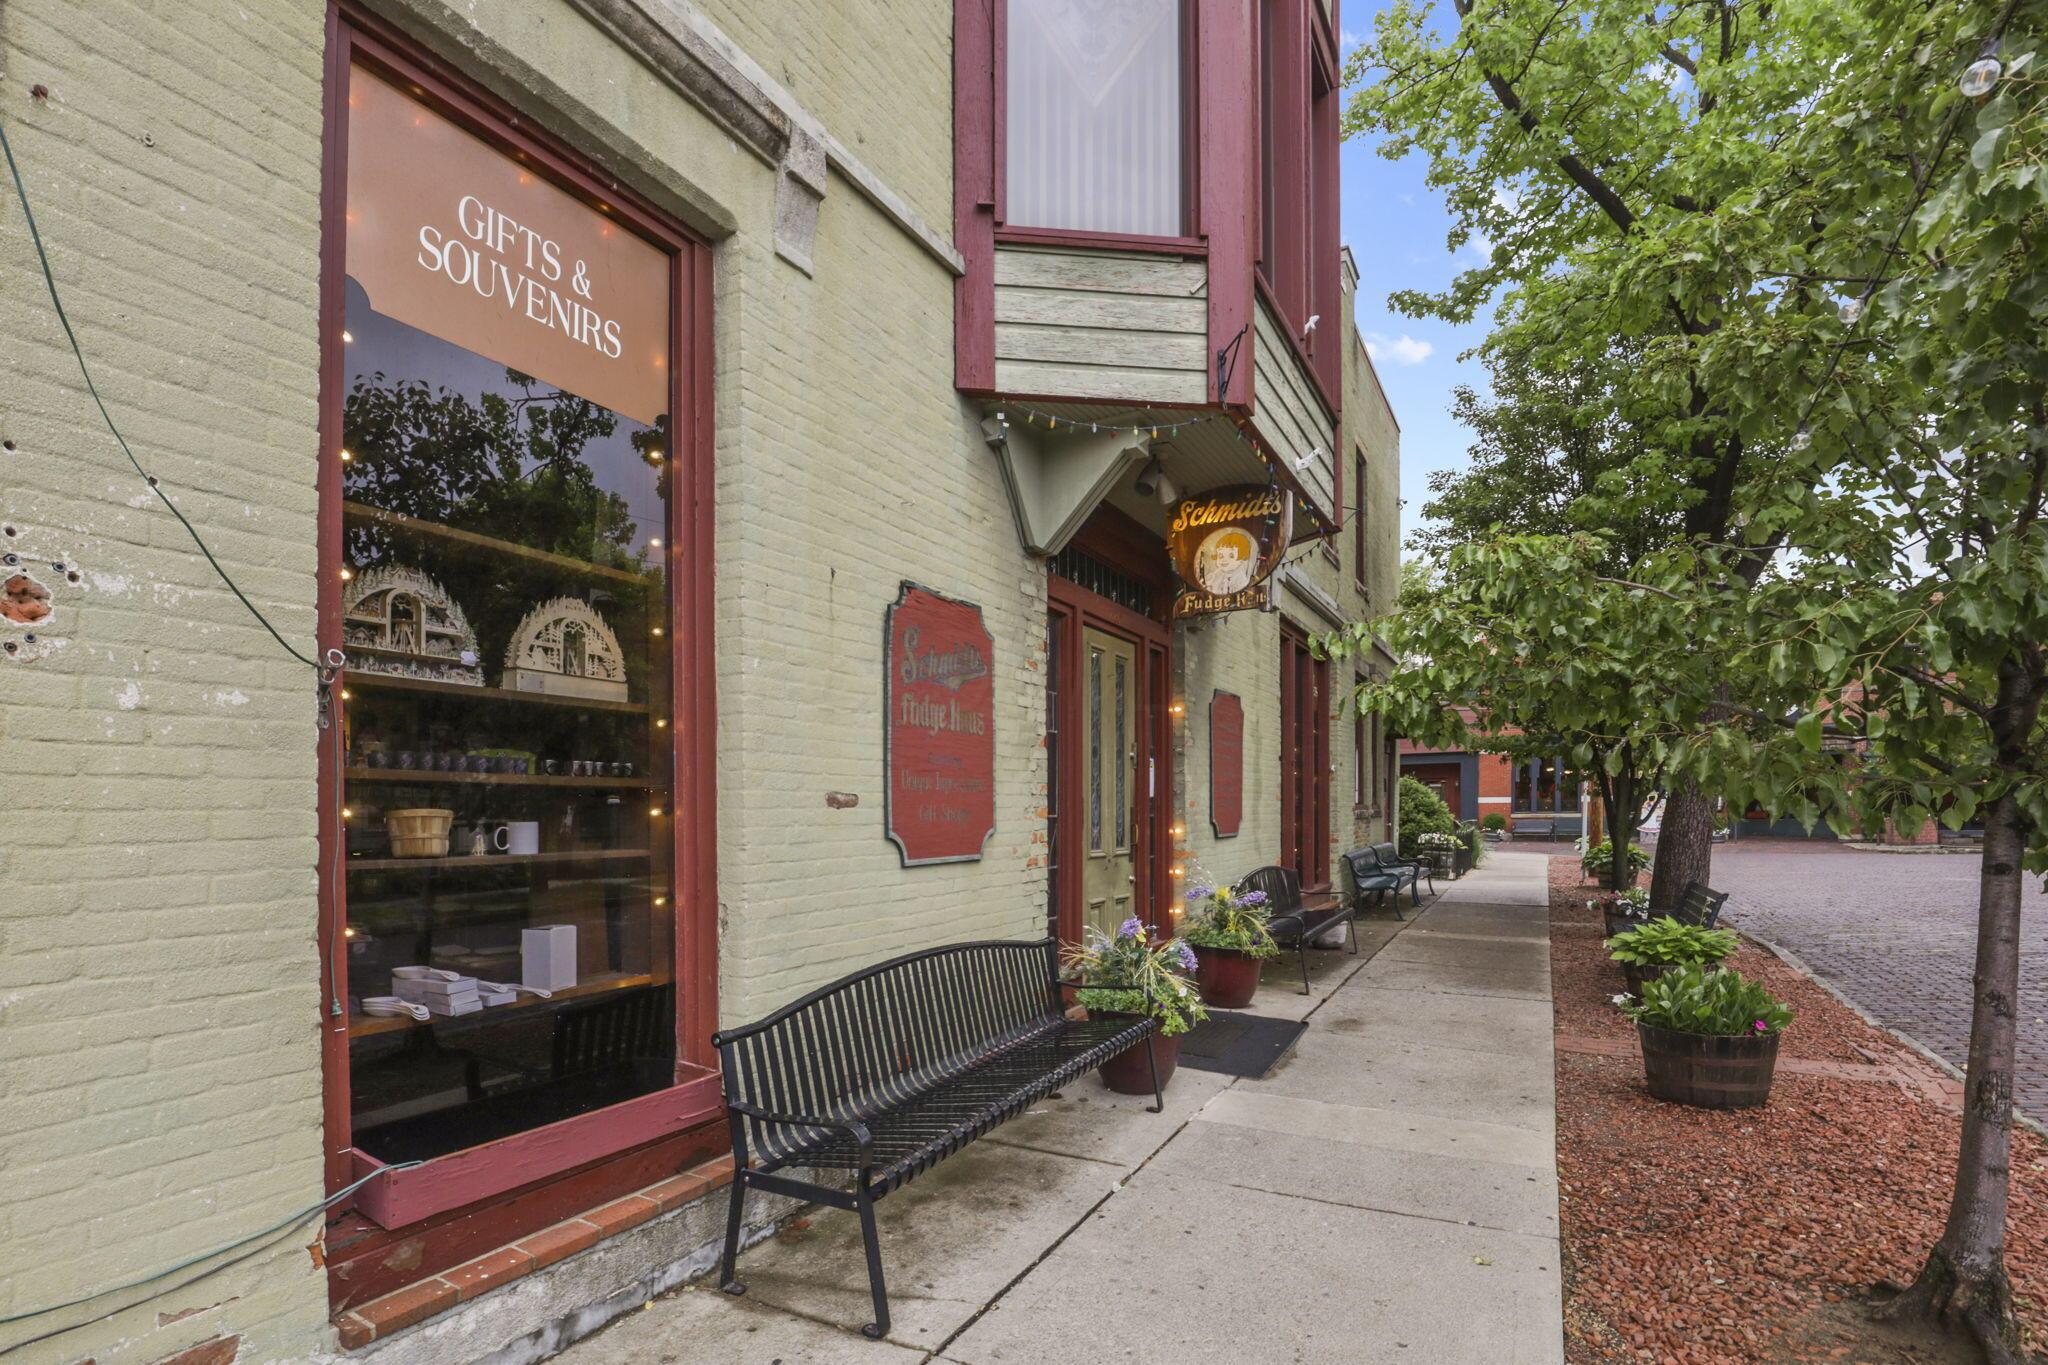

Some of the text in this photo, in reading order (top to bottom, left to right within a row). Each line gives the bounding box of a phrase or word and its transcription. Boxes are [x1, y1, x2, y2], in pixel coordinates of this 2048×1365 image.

[417, 225, 622, 359] SOUVENIRS
[458, 195, 593, 300] GIFTS &
[1180, 594, 1231, 613] Fudge
